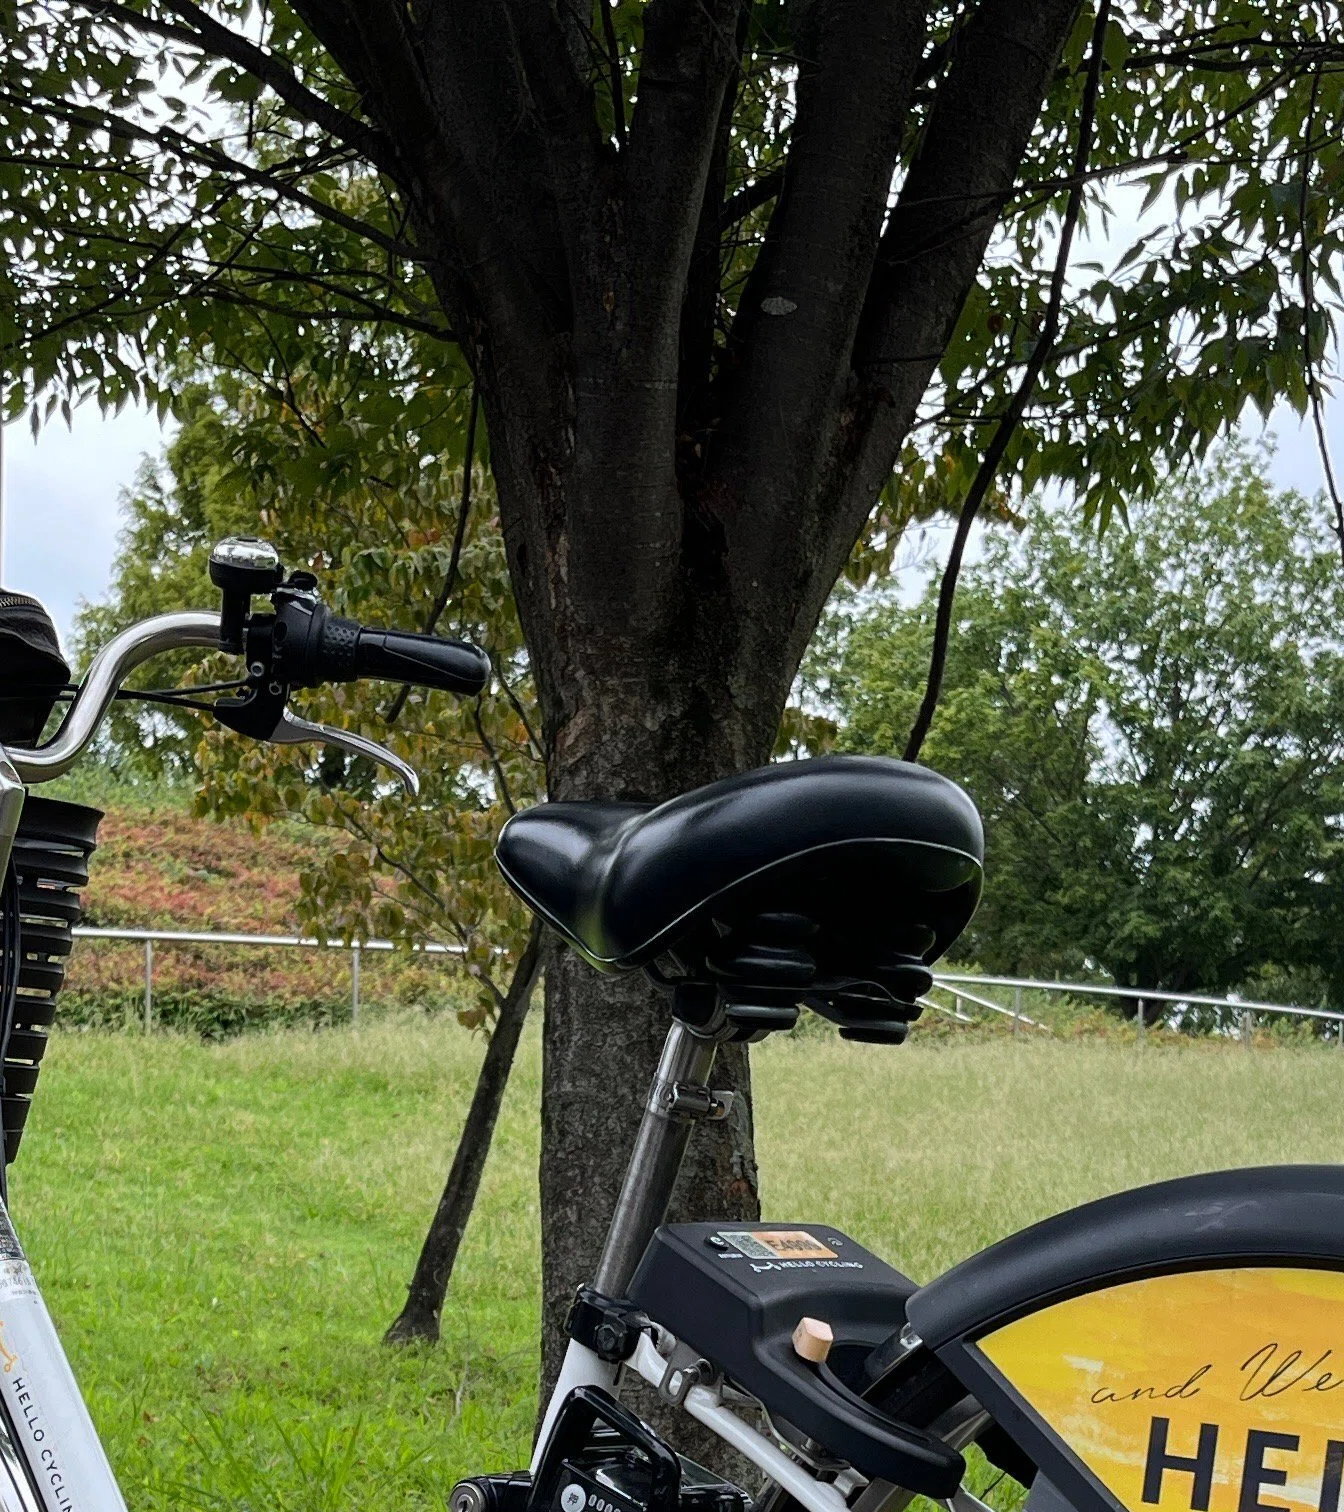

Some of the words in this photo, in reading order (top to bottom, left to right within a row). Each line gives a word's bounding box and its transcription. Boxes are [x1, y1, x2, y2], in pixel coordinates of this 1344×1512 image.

[1090, 1363, 1213, 1404] and
[1238, 1342, 1344, 1402] We
[12, 1377, 45, 1442] HELLO
